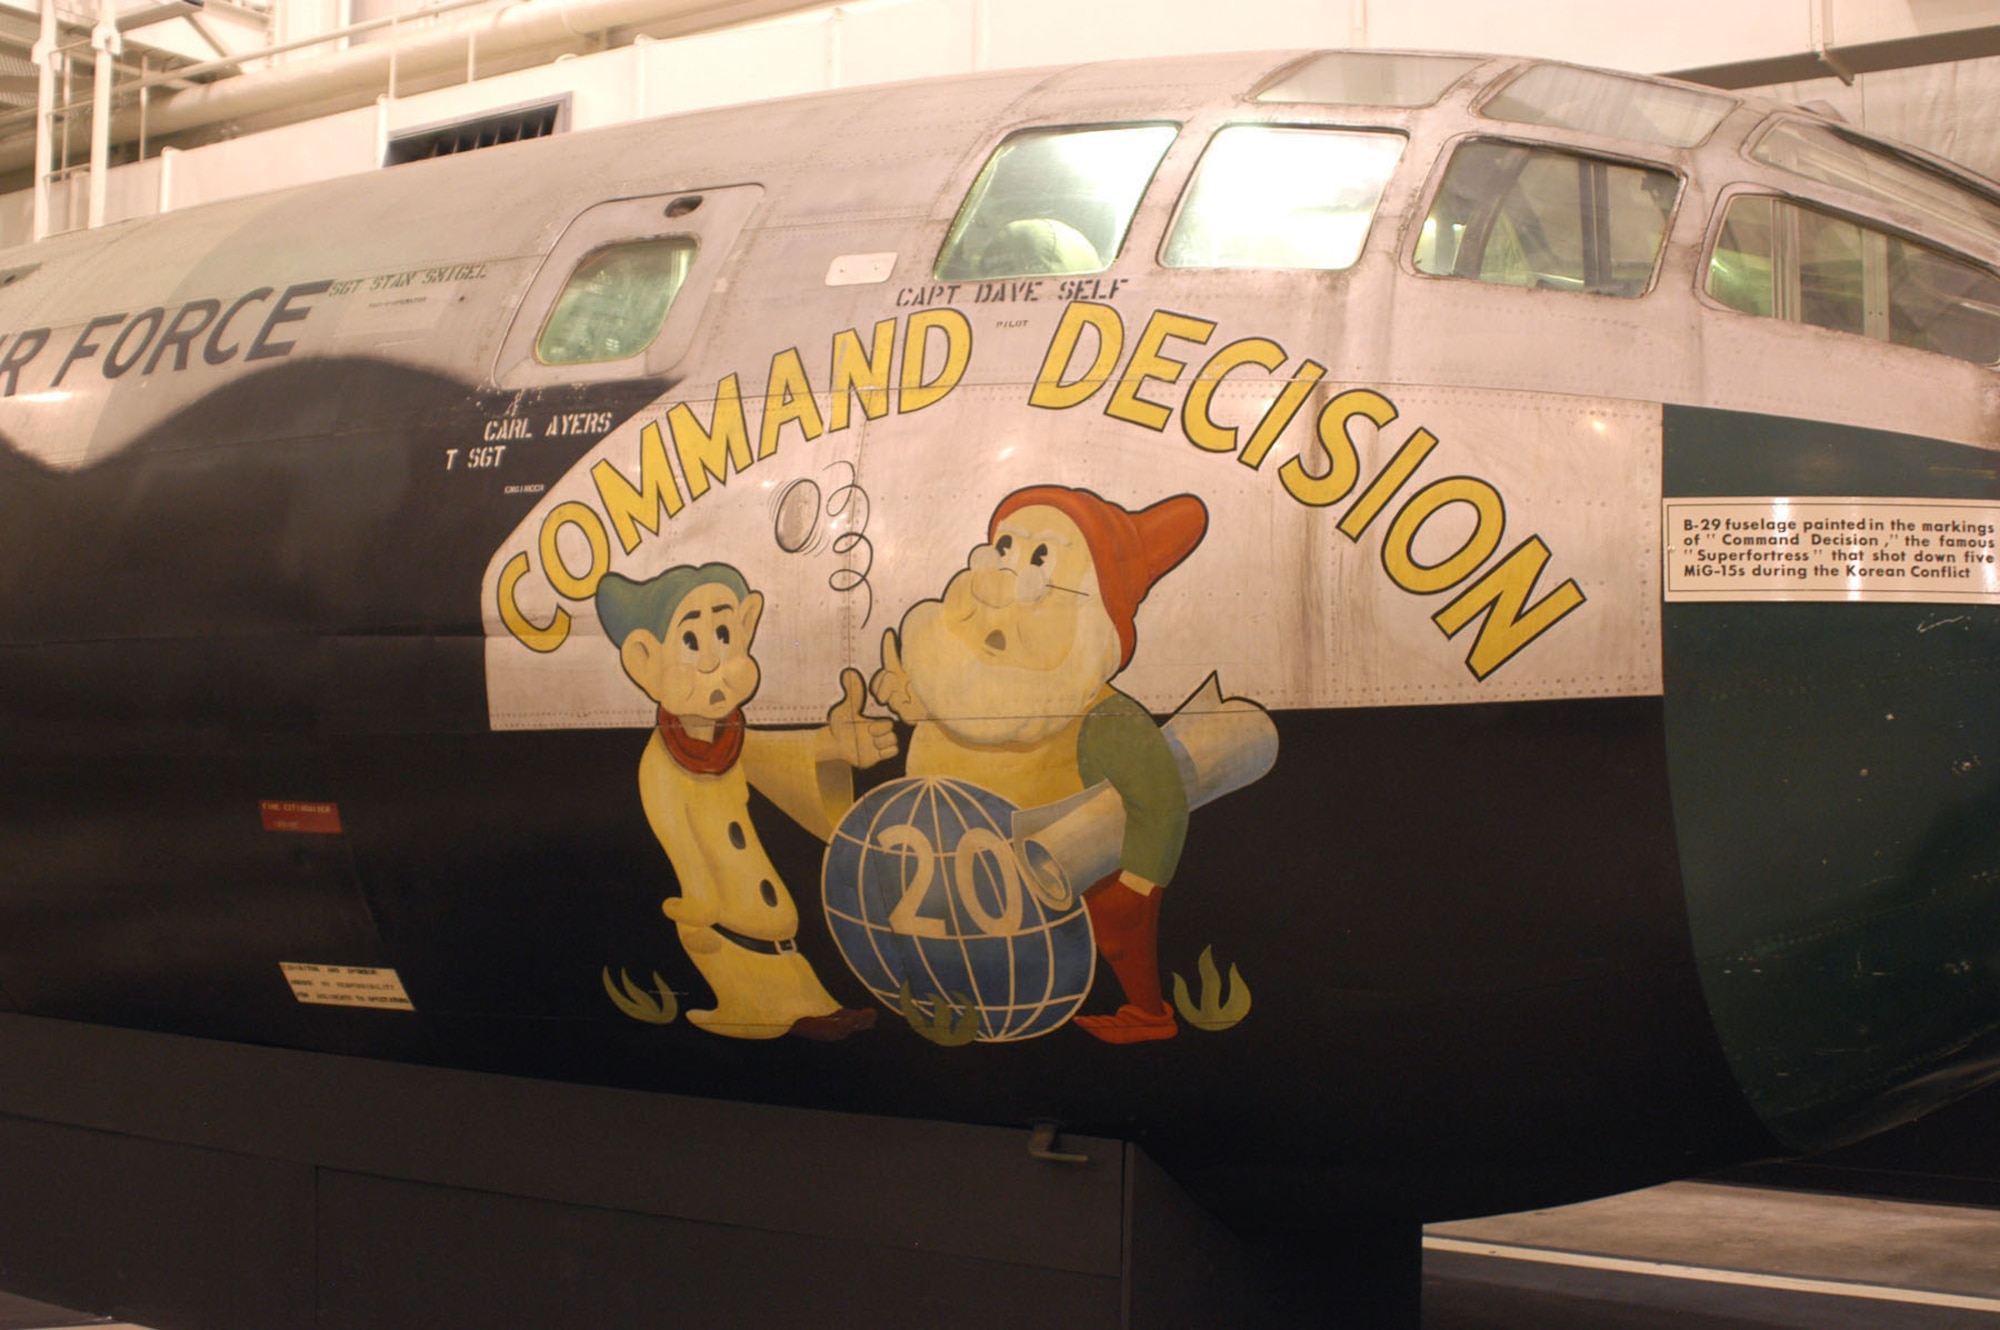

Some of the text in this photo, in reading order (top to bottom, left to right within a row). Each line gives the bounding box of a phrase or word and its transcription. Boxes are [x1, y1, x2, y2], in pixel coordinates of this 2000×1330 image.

[329, 279, 364, 297] SGT
[370, 272, 418, 291] STAN
[896, 279, 1129, 307] CAPT DAVE SELF
[995, 319, 1029, 329] PILOT
[0, 279, 335, 397] R FORCE
[483, 411, 613, 442] CARL AYERS
[446, 445, 507, 471] T SGT
[496, 300, 1587, 682] COMMAND DECISION
[1683, 517, 1995, 536] B-29 fuselage painted in the markings
[1683, 533, 1701, 546] of
[1905, 535, 1930, 548] the
[1939, 535, 1995, 549] famous
[1832, 549, 1864, 562] that
[1872, 550, 1906, 563] shot
[1914, 550, 1956, 563] down
[1964, 550, 1995, 564] five
[1683, 564, 1971, 579] MiG-15s during the Korean Conflict
[876, 823, 1023, 937] 20
